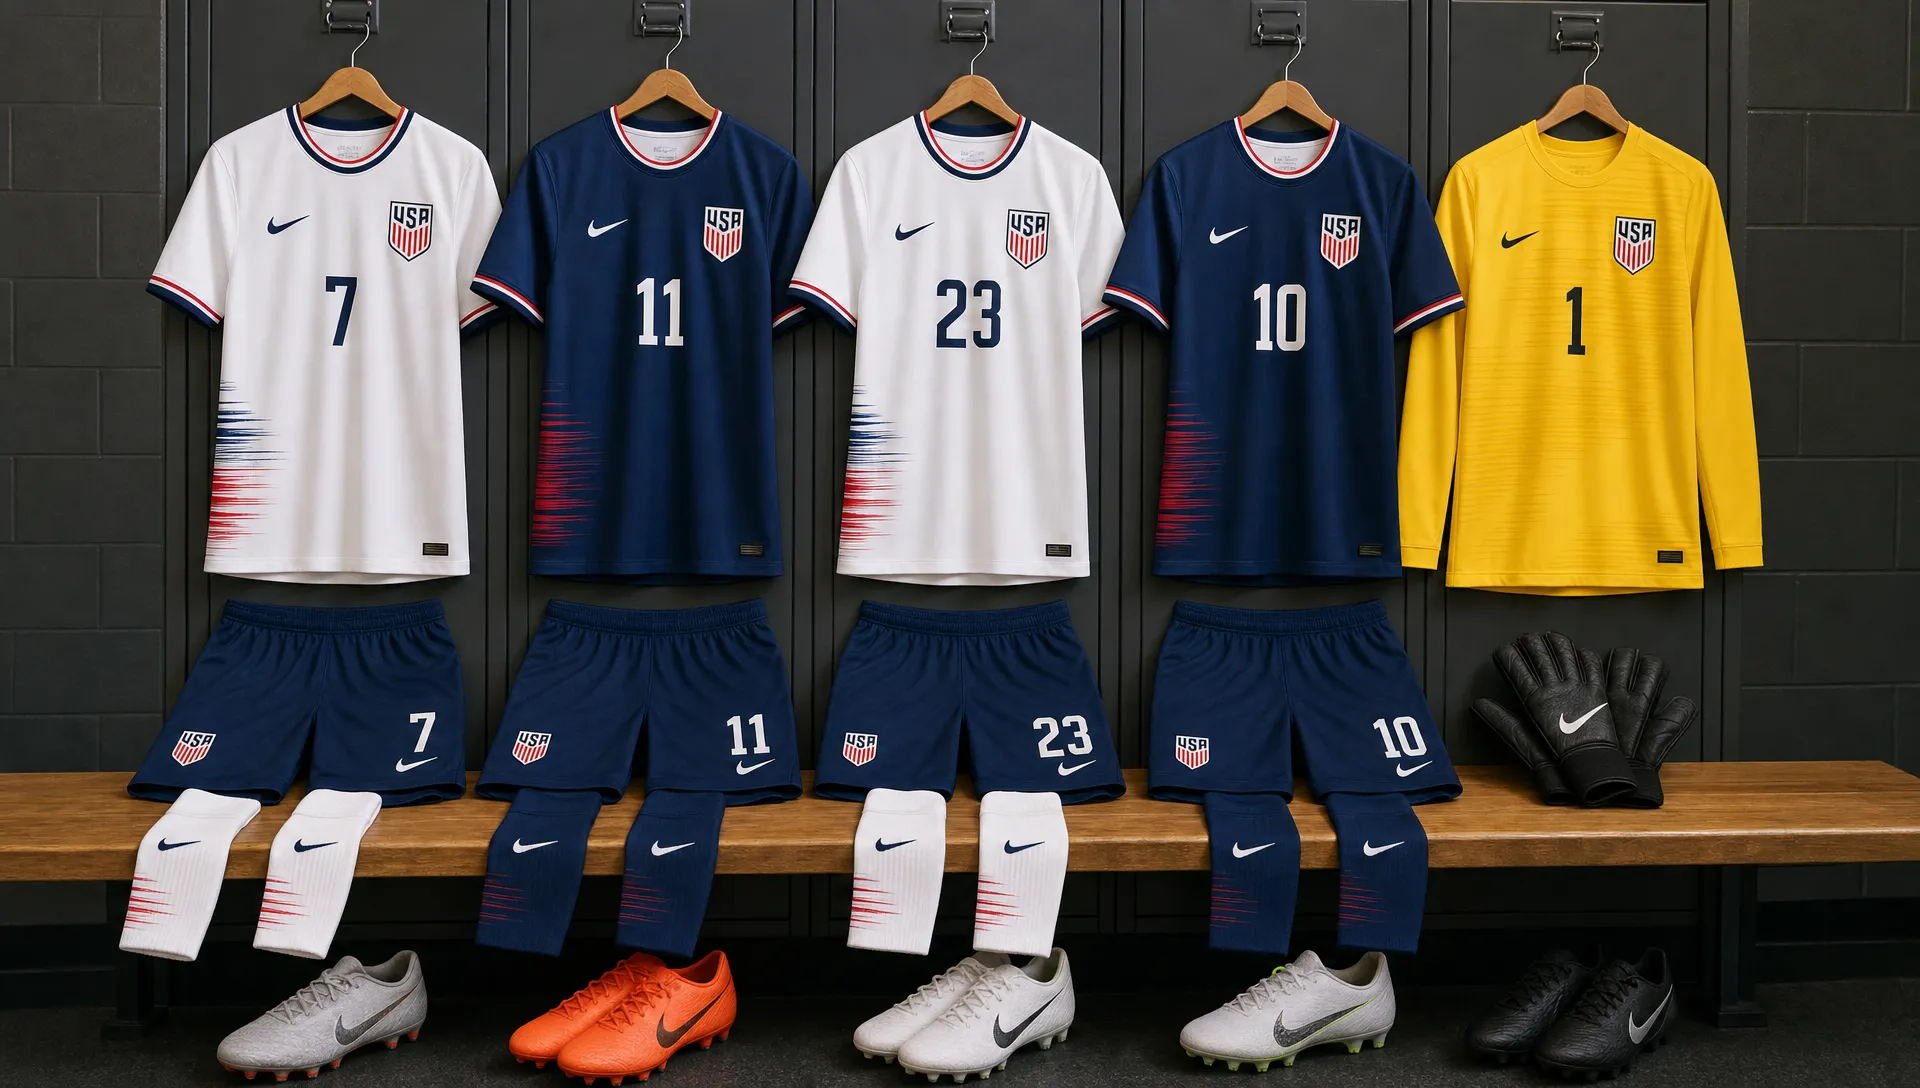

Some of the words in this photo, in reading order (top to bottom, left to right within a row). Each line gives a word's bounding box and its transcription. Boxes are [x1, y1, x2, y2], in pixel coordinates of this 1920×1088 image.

[393, 205, 429, 229] USA
[707, 210, 740, 232] USA
[1011, 214, 1046, 238] USA
[1323, 216, 1359, 238] USA
[1618, 221, 1652, 243] USA
[325, 276, 357, 346] 7
[637, 278, 683, 346] 11
[936, 279, 1001, 348] 23
[1253, 284, 1306, 350] 10
[1566, 287, 1586, 355] 1
[182, 732, 212, 747] USA
[409, 712, 435, 752] 7
[519, 732, 549, 746] USA
[727, 714, 770, 755] 11
[847, 735, 875, 748] USA
[1033, 715, 1092, 757] 23
[1178, 738, 1208, 751] USA
[1373, 716, 1427, 758] 10
